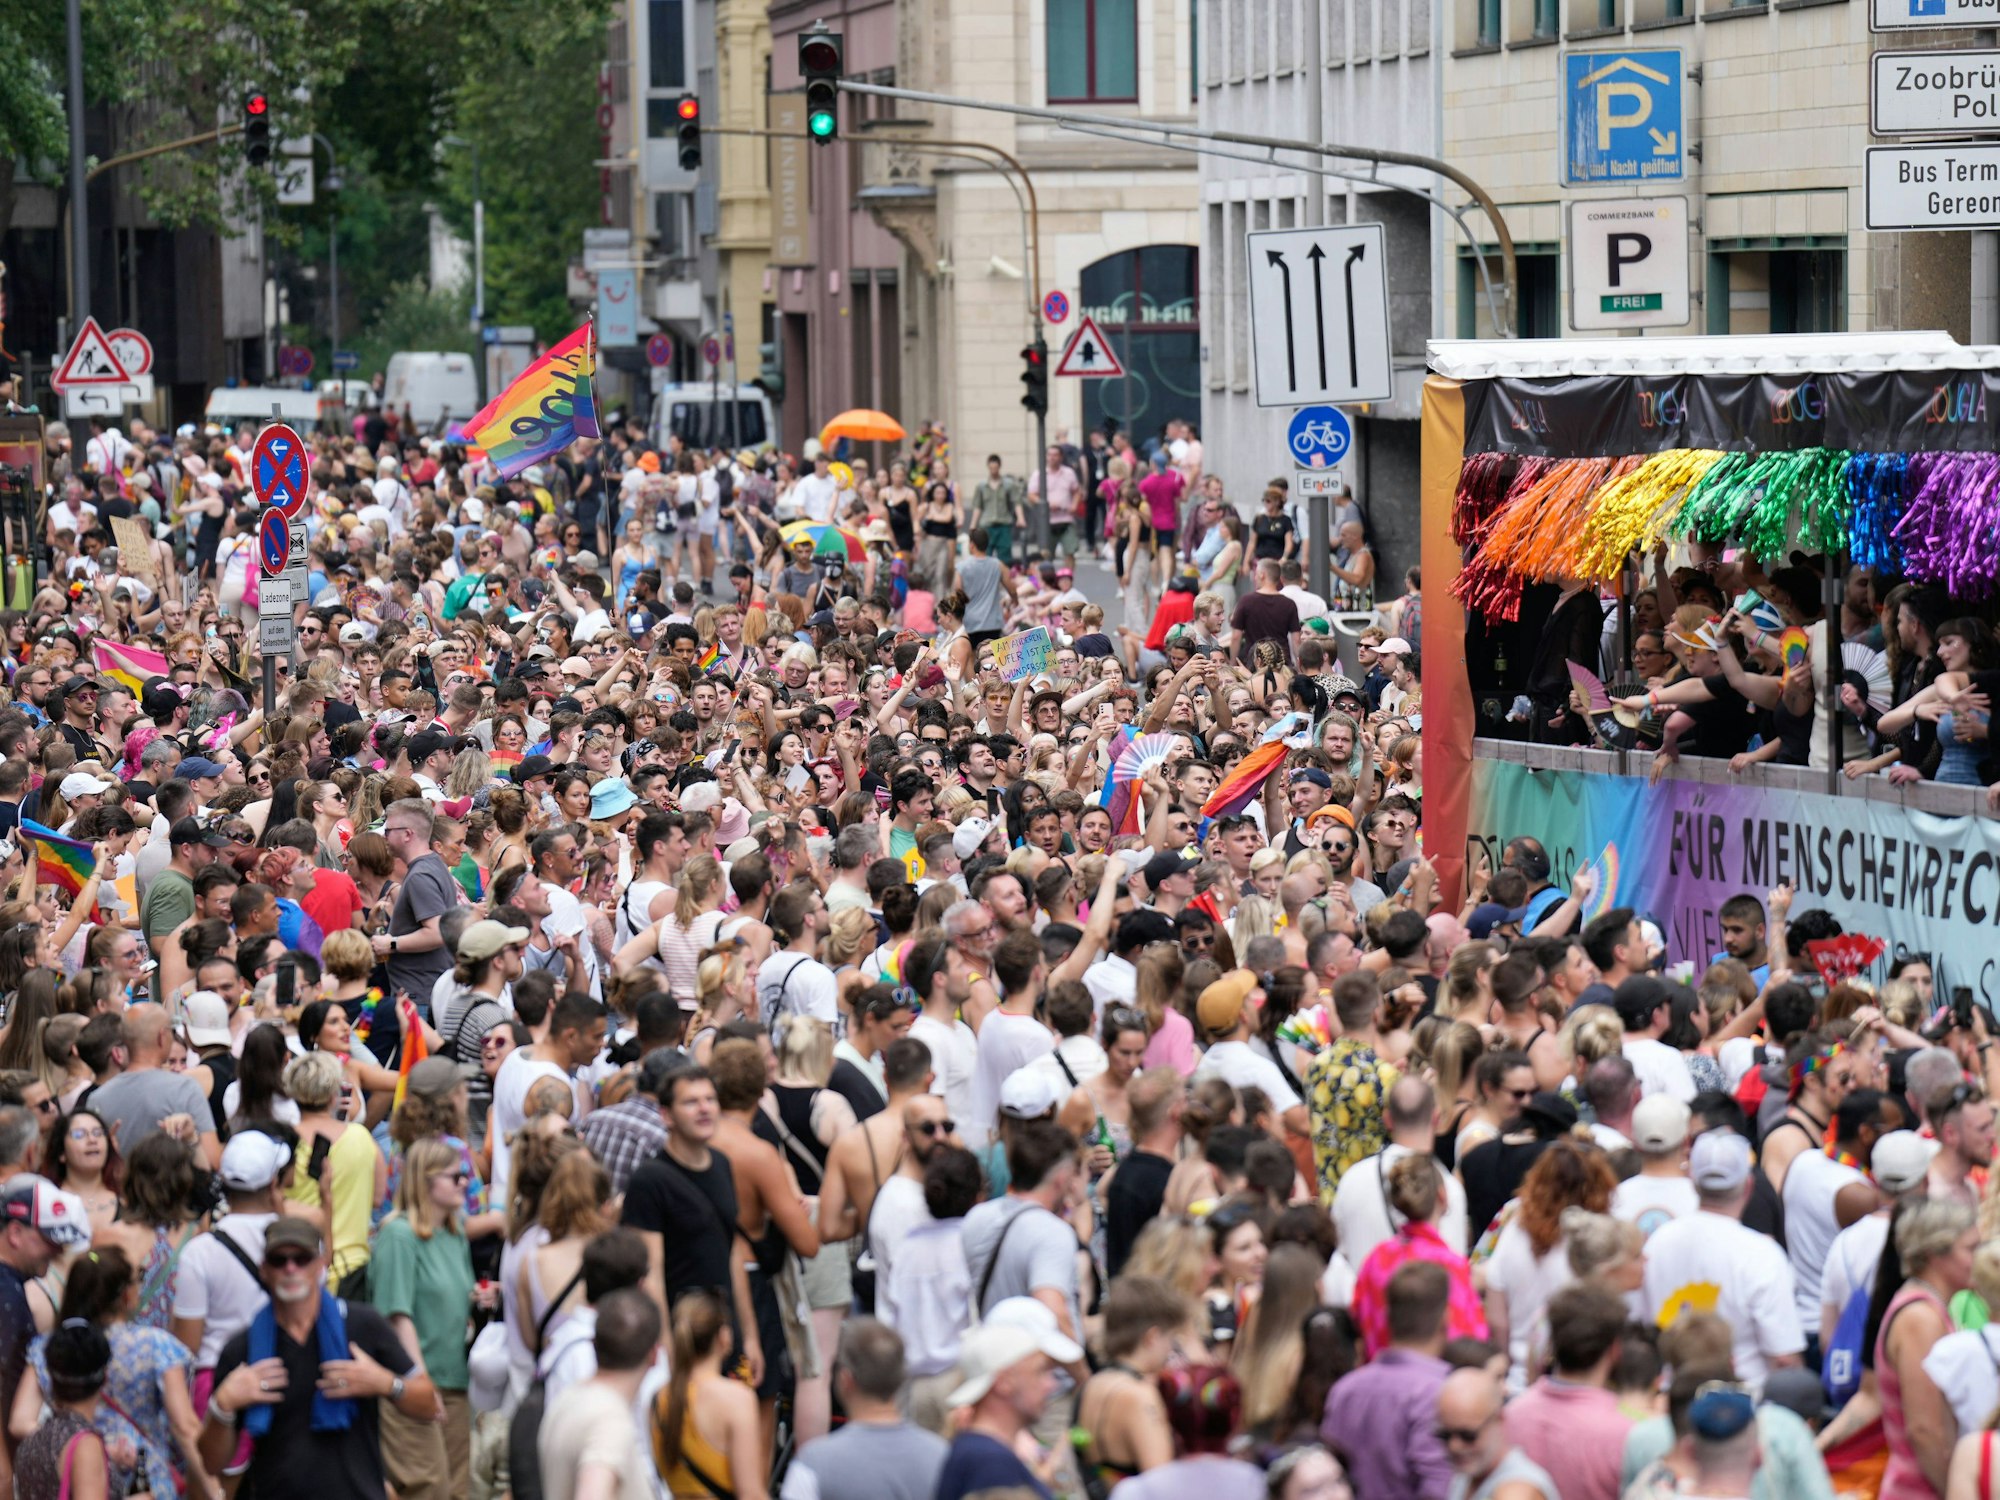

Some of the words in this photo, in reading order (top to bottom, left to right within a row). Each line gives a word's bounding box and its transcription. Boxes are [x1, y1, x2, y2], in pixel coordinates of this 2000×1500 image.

[1896, 65, 2000, 91] Zoobrü
[1597, 82, 1652, 150] P
[1954, 94, 1997, 118] Pol
[1610, 159, 1637, 176] Nacht
[1641, 157, 1680, 177] geöffnet
[1899, 160, 1937, 183] Bus
[1944, 158, 1998, 182] Term
[1588, 210, 1655, 221] COMMERZBANK
[1607, 232, 1652, 287] P
[1613, 296, 1646, 309] FREI
[1303, 477, 1339, 489] Ende
[262, 592, 289, 604] Ladezone
[276, 625, 285, 634] dem
[262, 636, 290, 647] Seitenstreifen
[997, 640, 1010, 653] AM
[1011, 633, 1042, 648] ANDEREN
[999, 651, 1024, 666] UFER
[1026, 646, 1039, 657] IST
[1042, 644, 1051, 654] ES
[1669, 792, 1726, 883] FÜR
